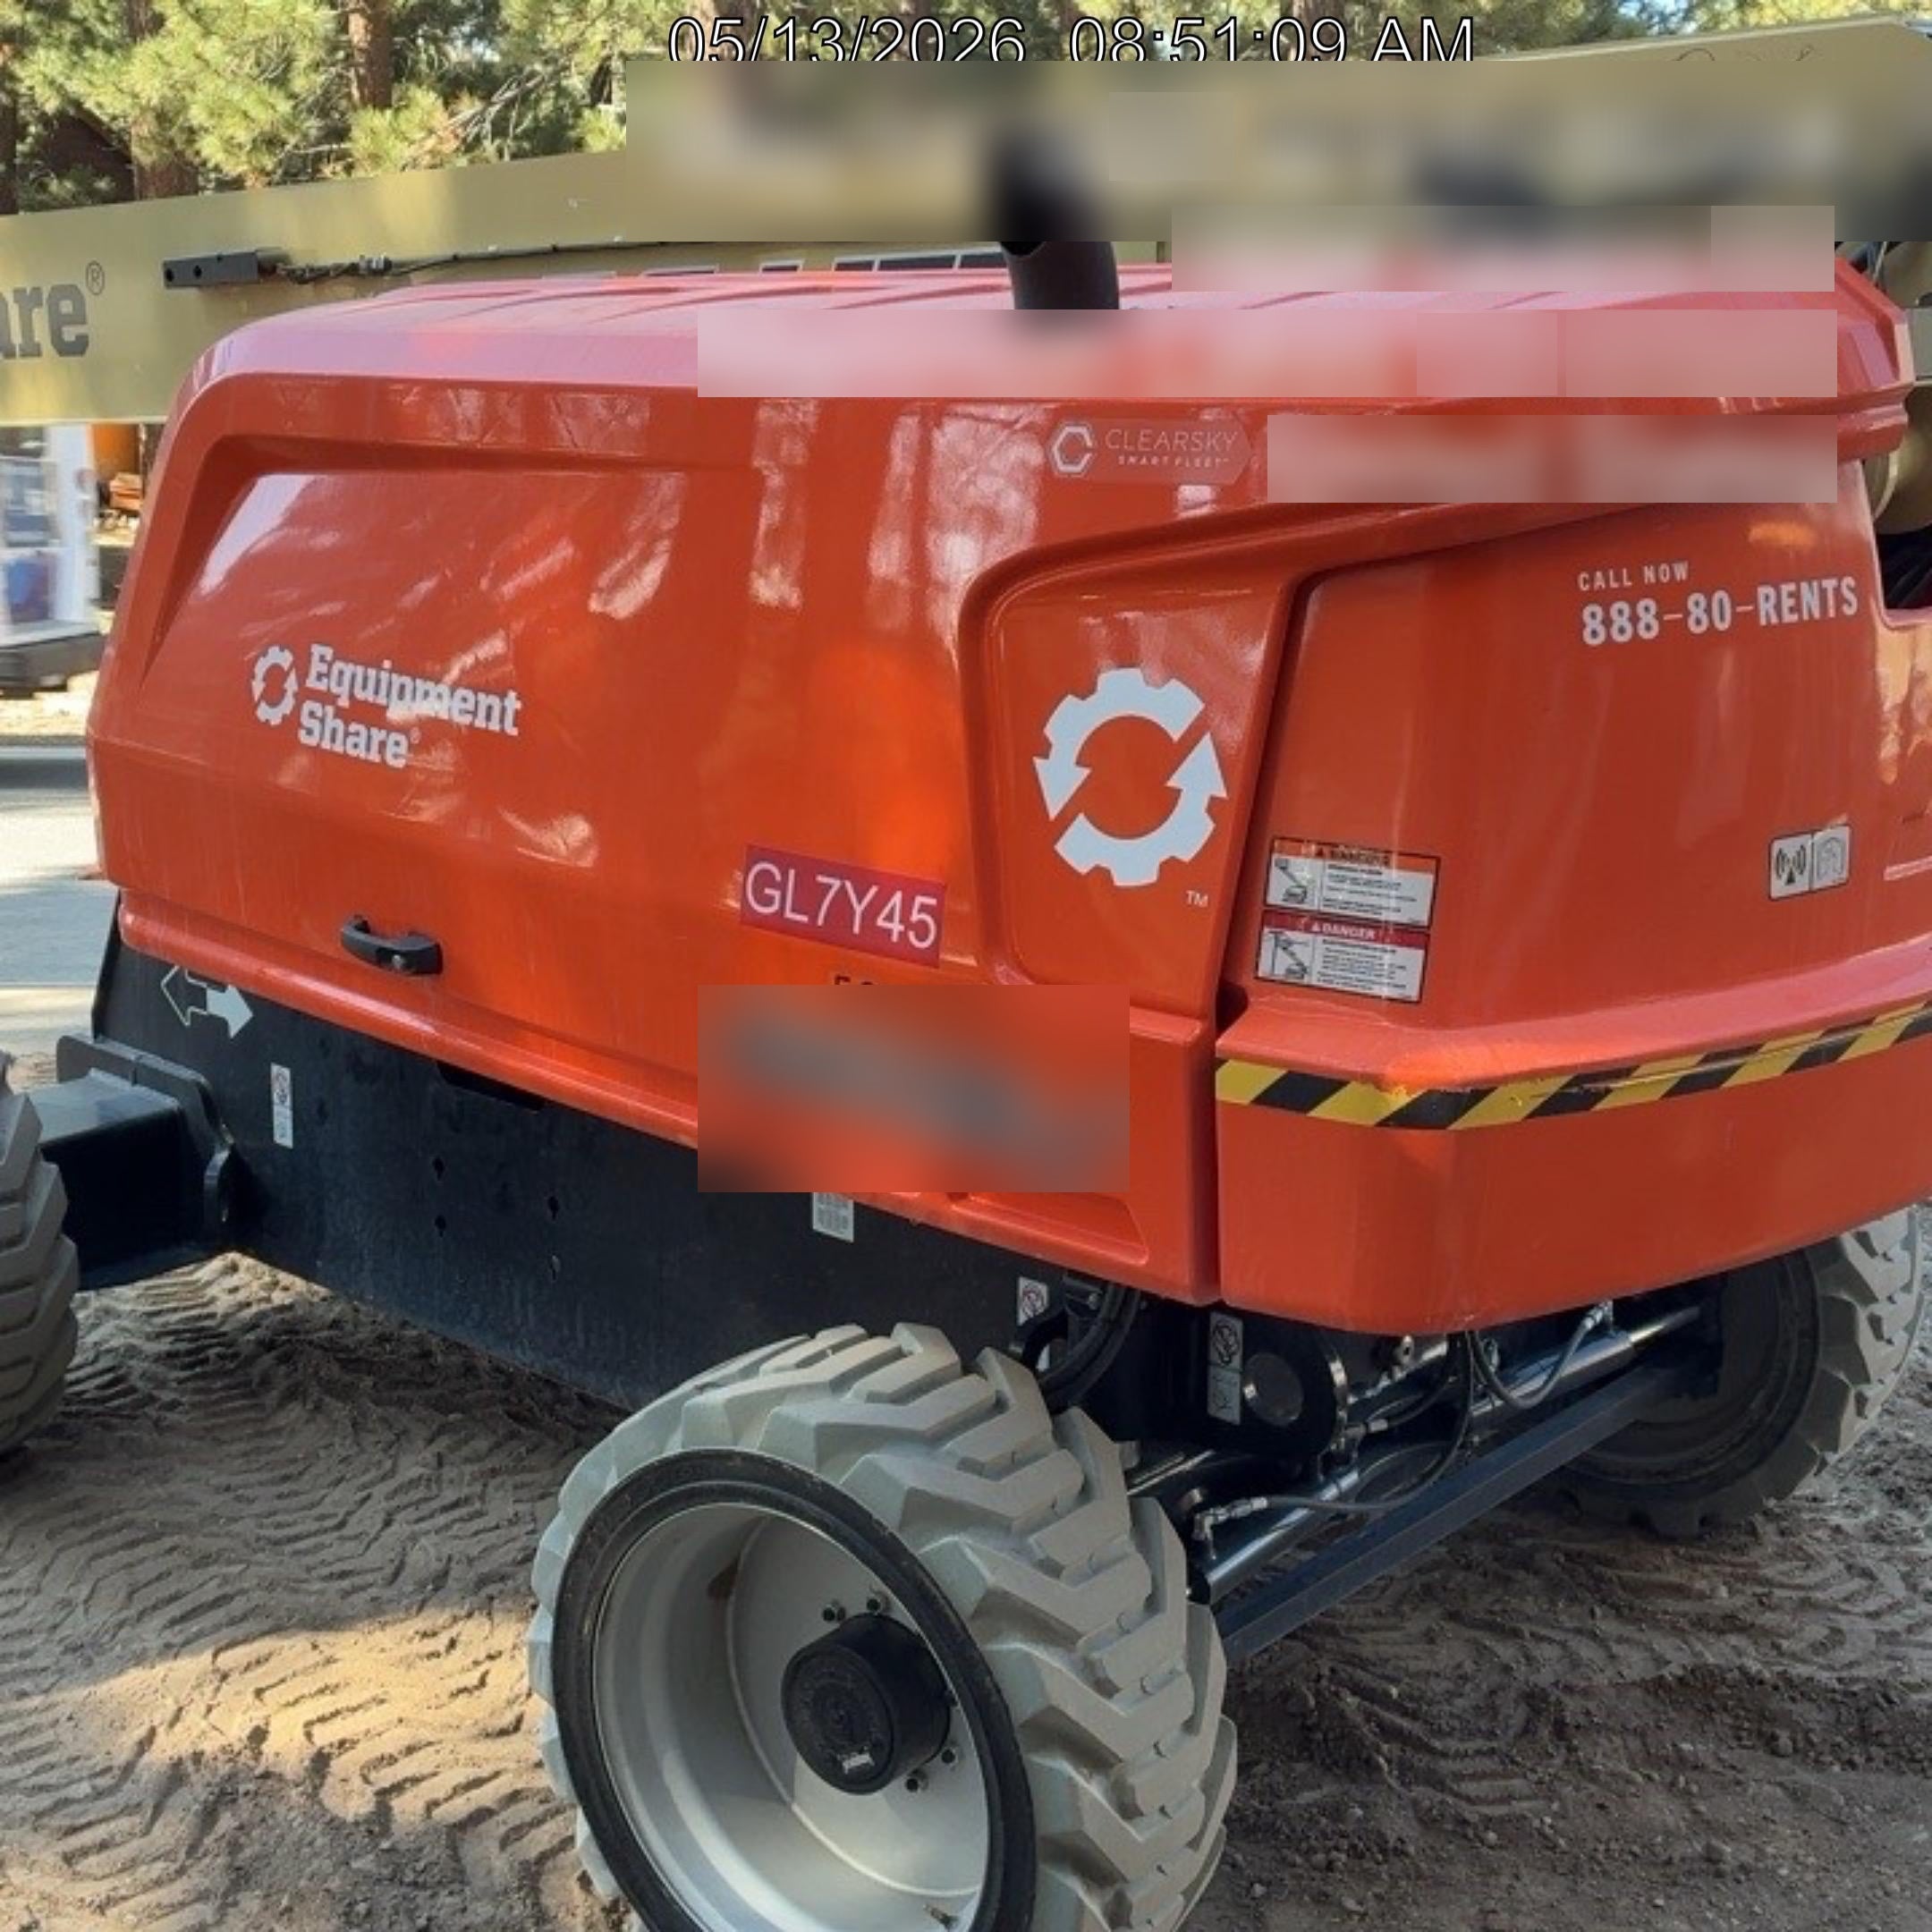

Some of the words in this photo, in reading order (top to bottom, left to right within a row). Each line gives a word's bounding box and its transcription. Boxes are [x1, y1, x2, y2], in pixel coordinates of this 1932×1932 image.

[1105, 428, 1238, 452] CLEARSKY
[1578, 567, 1632, 591] CALL
[1643, 561, 1690, 583] NOW
[1581, 575, 1859, 646] 888-80-RENTS
[305, 642, 522, 736] Equipment
[745, 860, 938, 949] GL7Y45
[1322, 922, 1376, 941] DANGER
